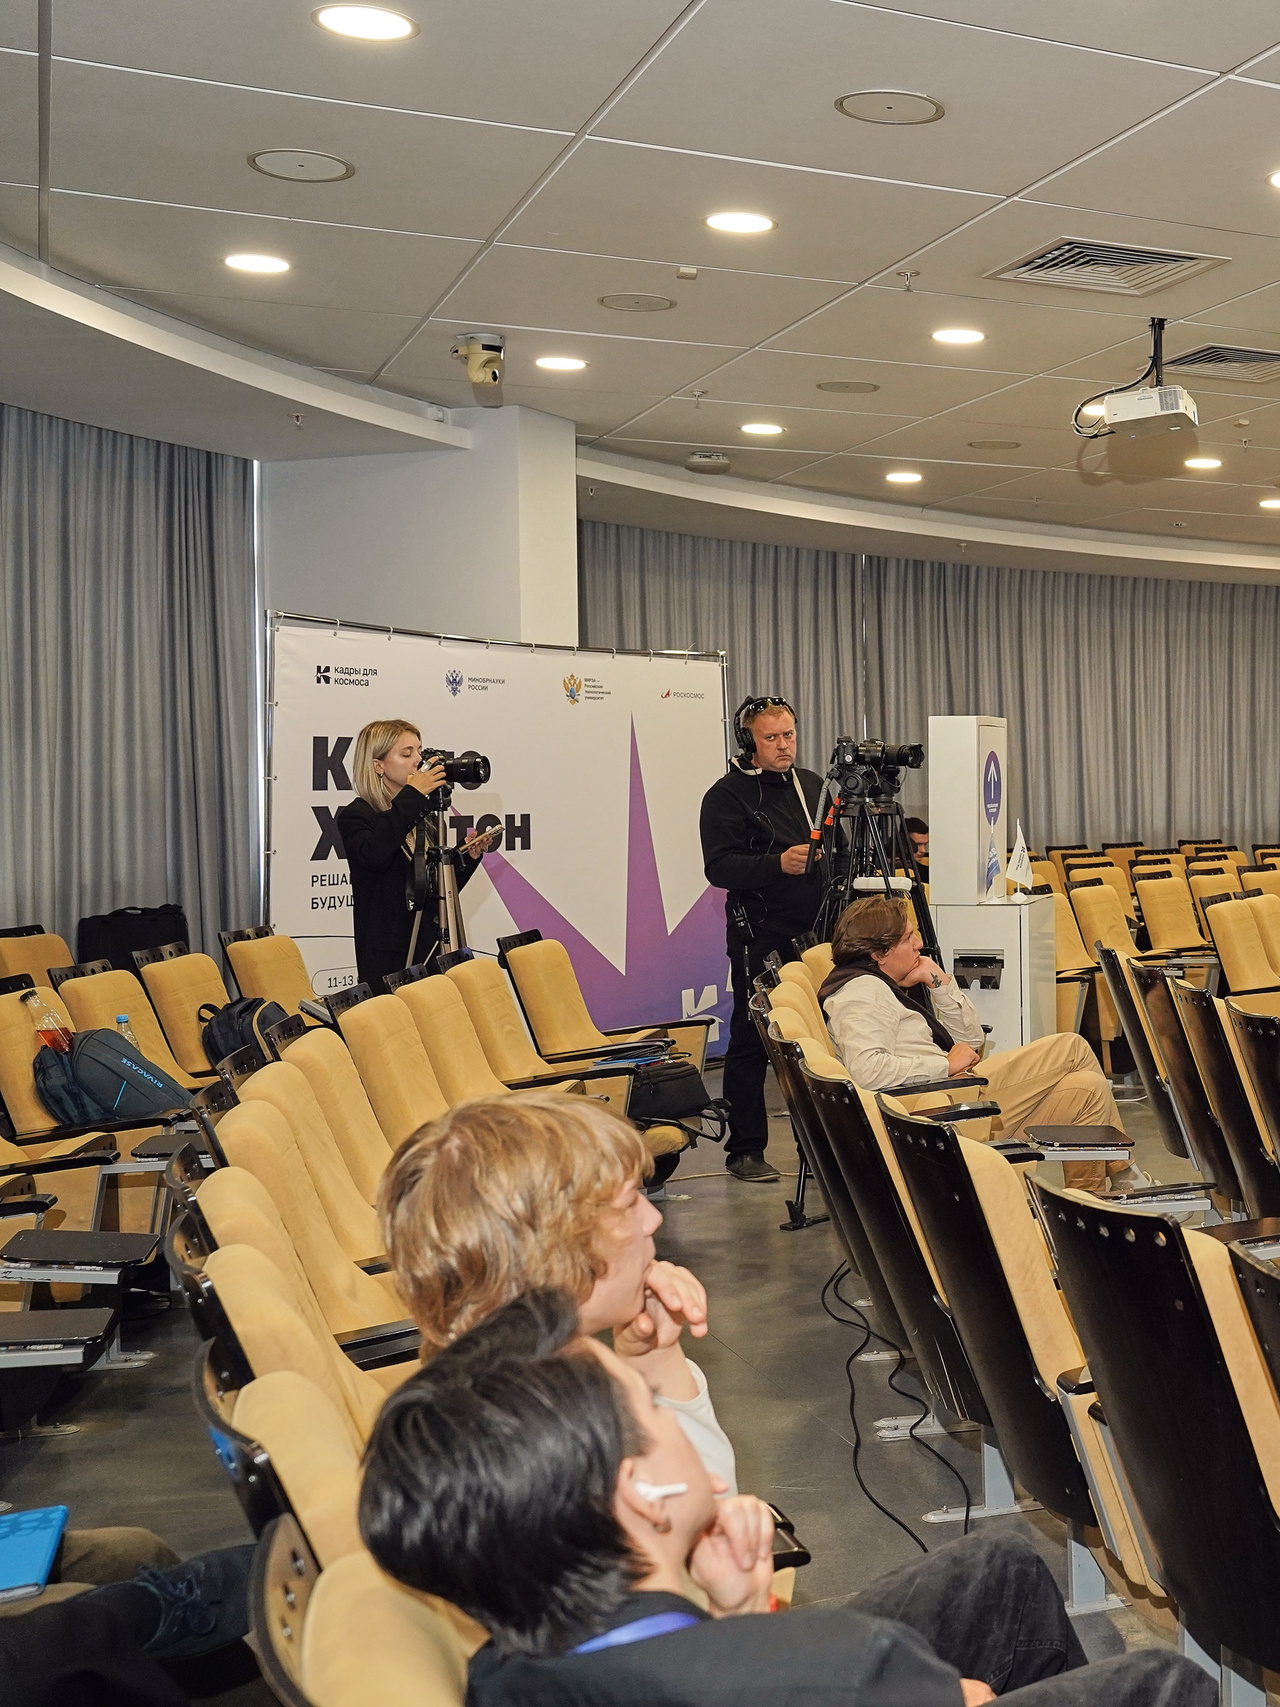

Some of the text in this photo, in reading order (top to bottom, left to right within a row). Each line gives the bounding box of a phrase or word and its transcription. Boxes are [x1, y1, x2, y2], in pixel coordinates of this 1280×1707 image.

[334, 666, 378, 677] кадры для
[334, 677, 370, 687] космоса
[467, 676, 506, 685] МИНОБРНАУКИ
[467, 684, 489, 692] РОССИИ
[673, 692, 705, 700] РОСКОСМОС
[327, 975, 354, 989] 11-13
[121, 1057, 164, 1088] RIVACASE
